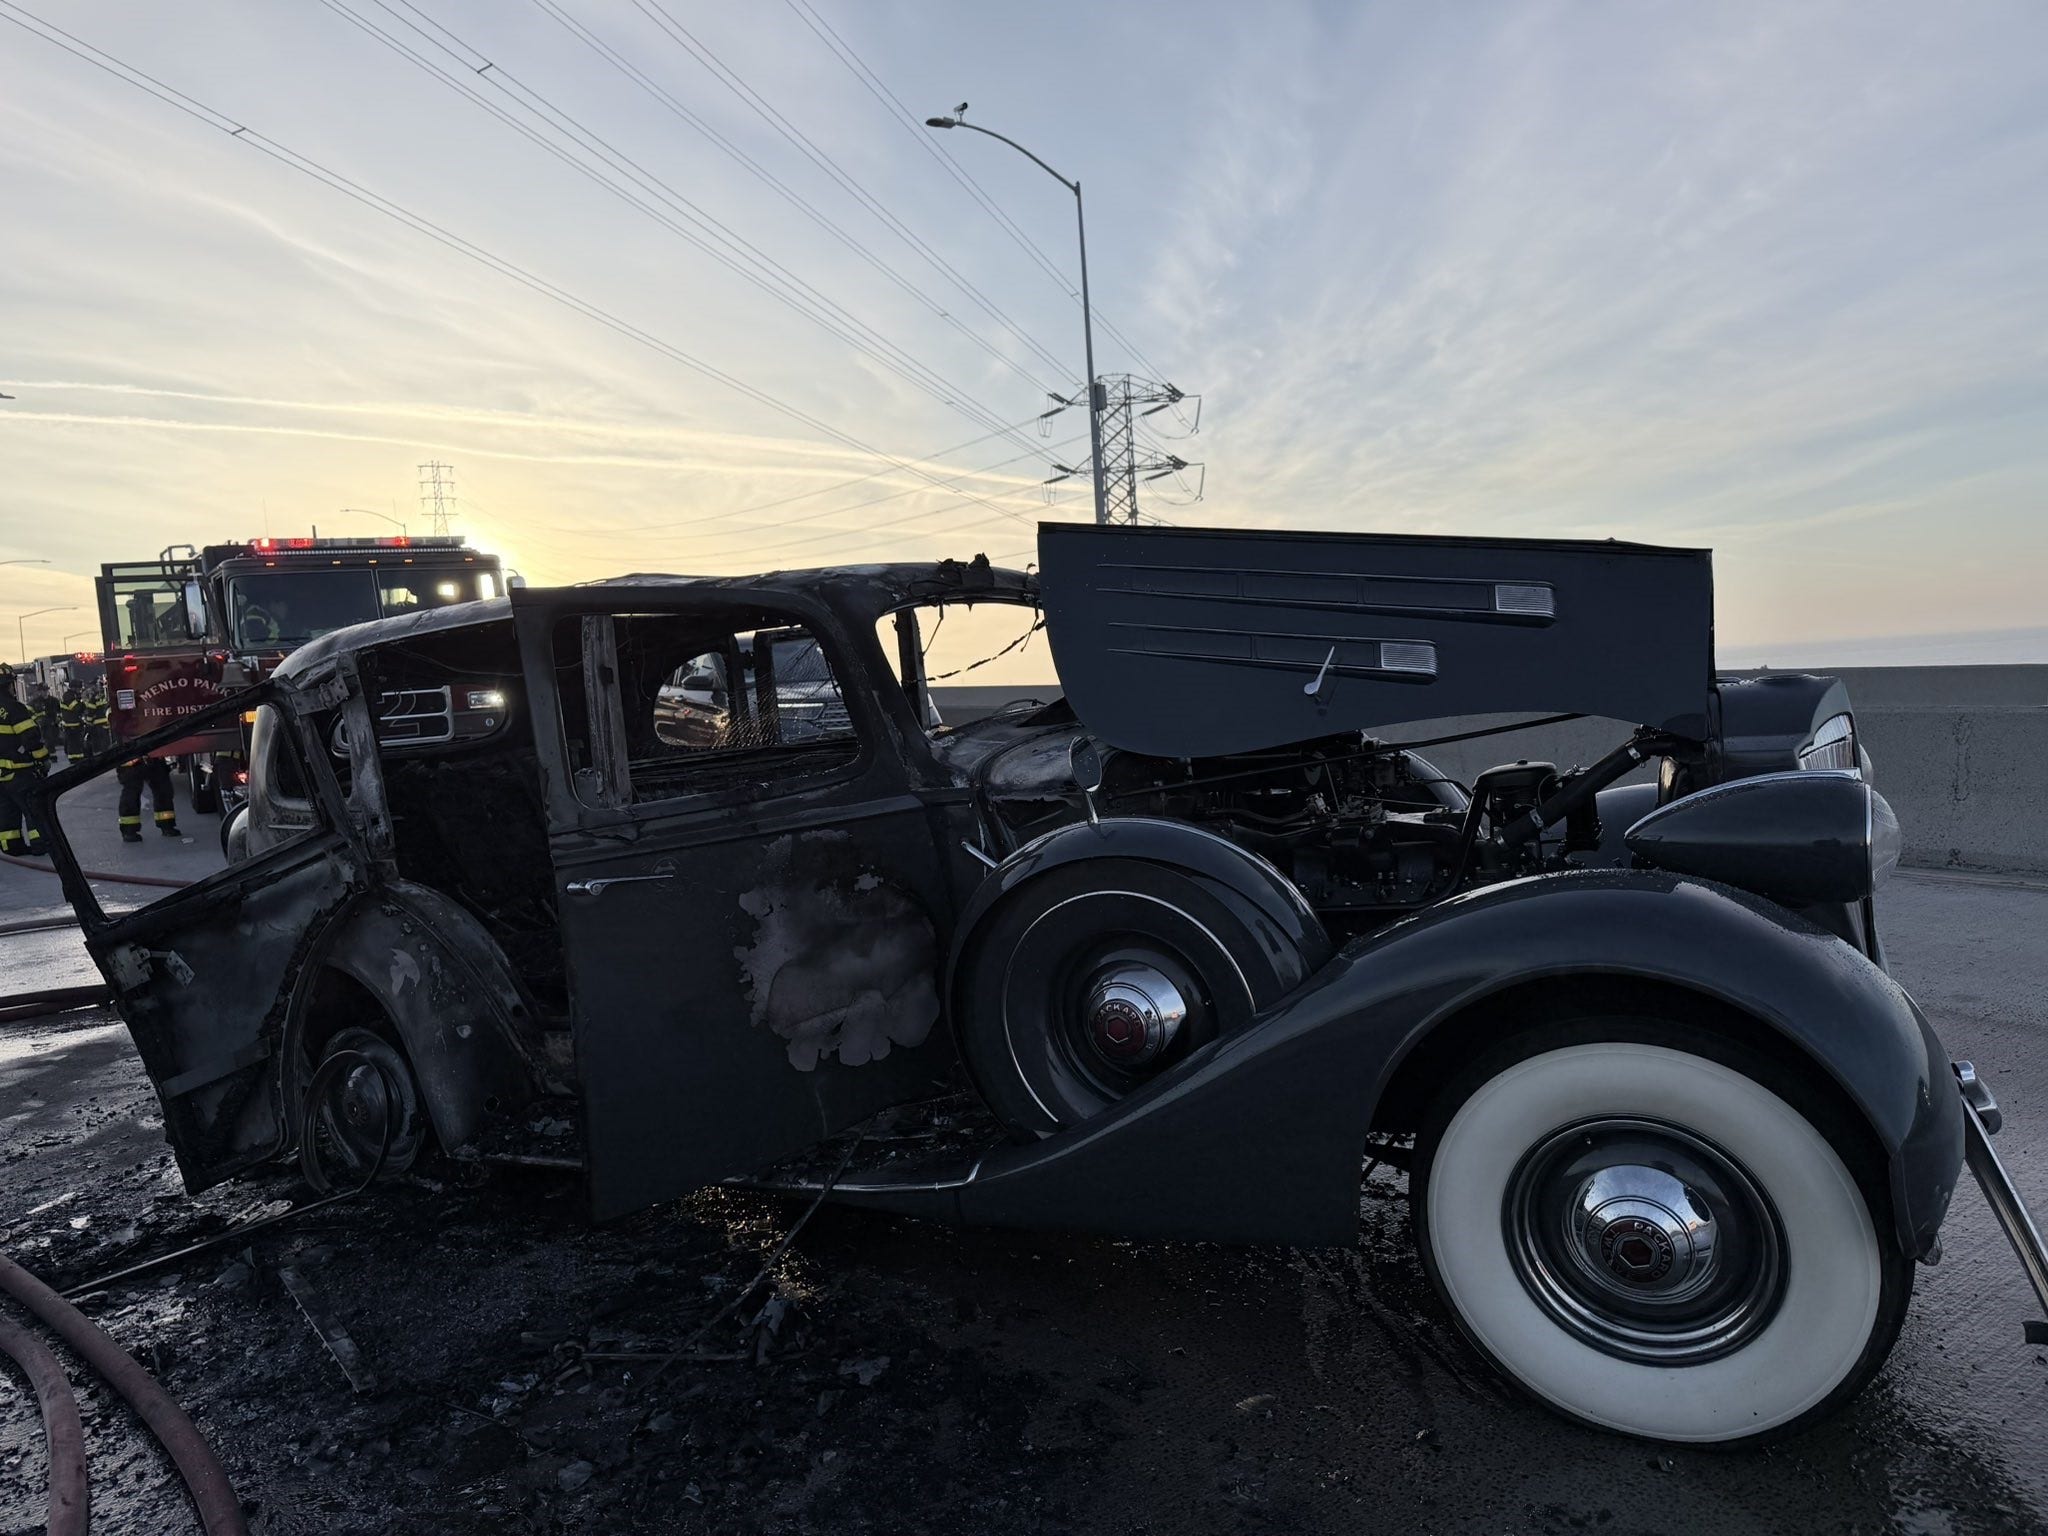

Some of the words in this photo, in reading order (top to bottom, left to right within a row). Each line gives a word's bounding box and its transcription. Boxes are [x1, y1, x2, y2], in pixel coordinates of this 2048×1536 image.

[139, 678, 189, 702] MENLO
[193, 678, 231, 697] PARK
[144, 707, 173, 717] FIRE
[177, 704, 208, 715] DIST
[1097, 1004, 1141, 1027] PACKARD
[1632, 1221, 1672, 1278] PACKARD
